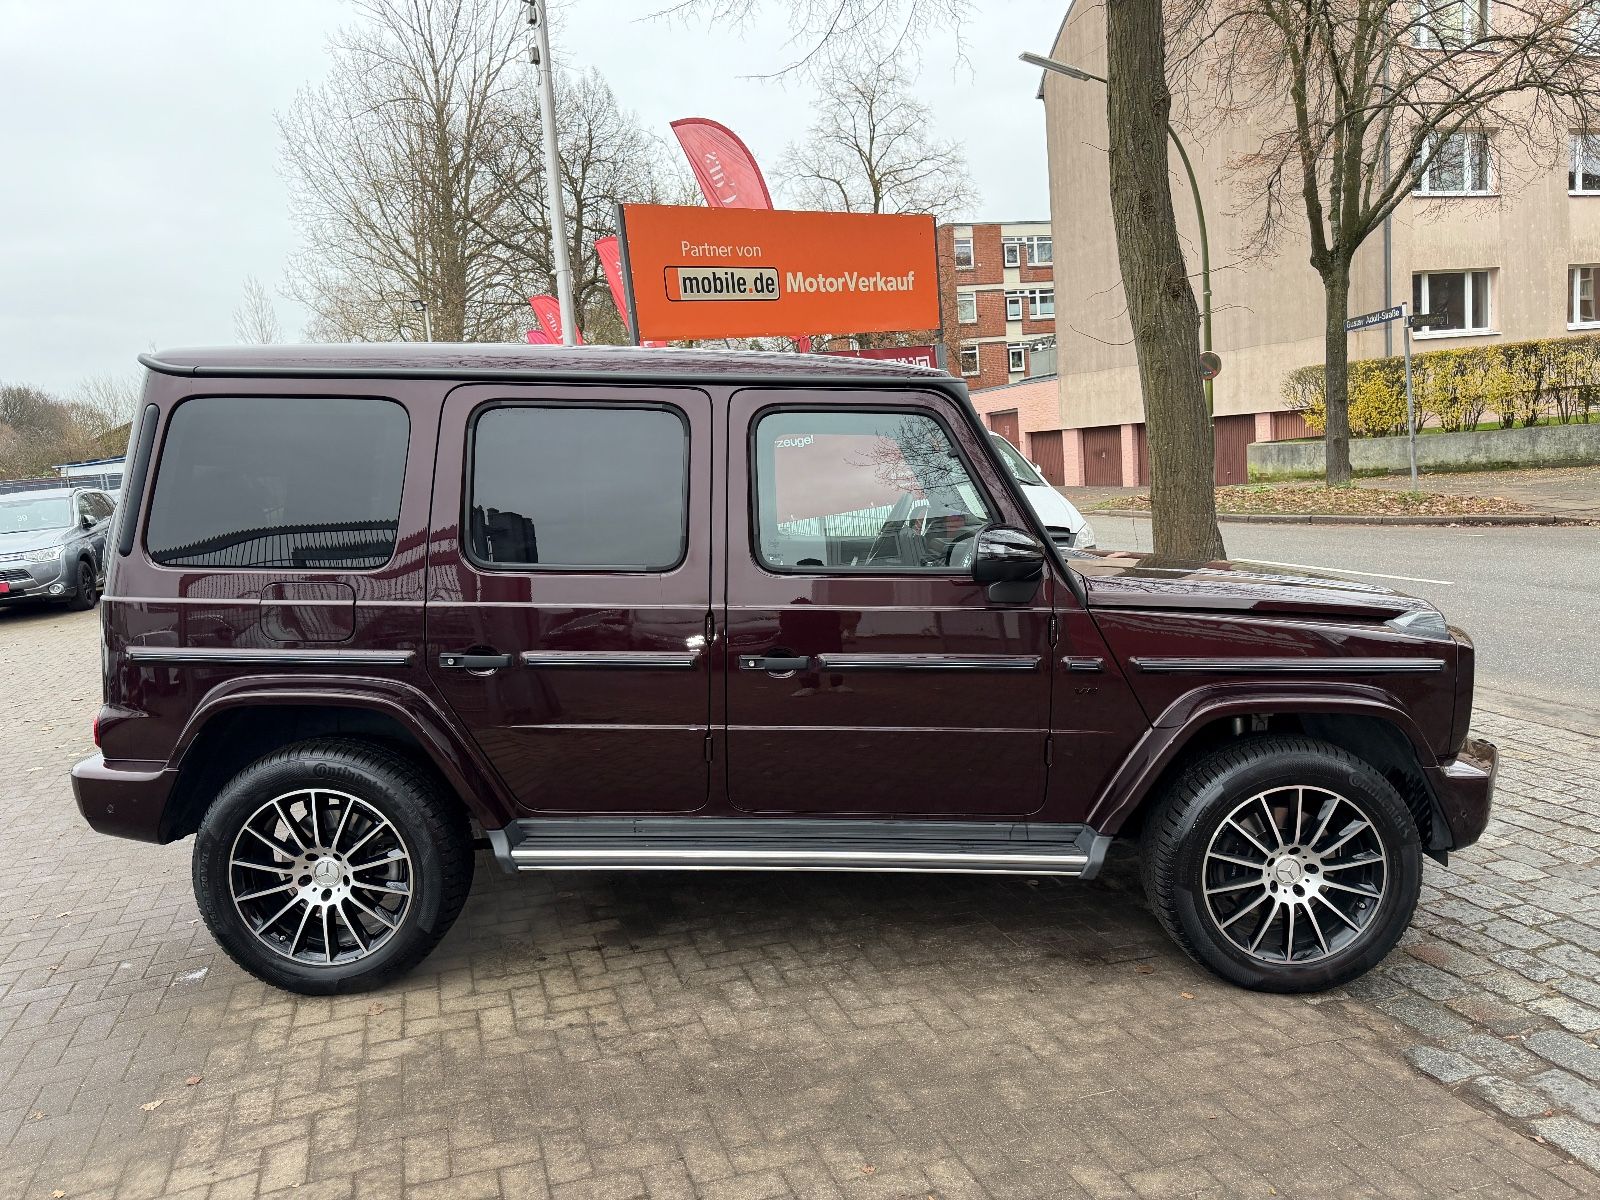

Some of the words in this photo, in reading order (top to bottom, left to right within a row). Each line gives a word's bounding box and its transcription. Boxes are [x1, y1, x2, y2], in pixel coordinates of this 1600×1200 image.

[681, 240, 733, 257] Partner
[735, 246, 762, 257] von
[682, 271, 775, 294] mobile.de
[786, 270, 915, 293] MotorVerkauf
